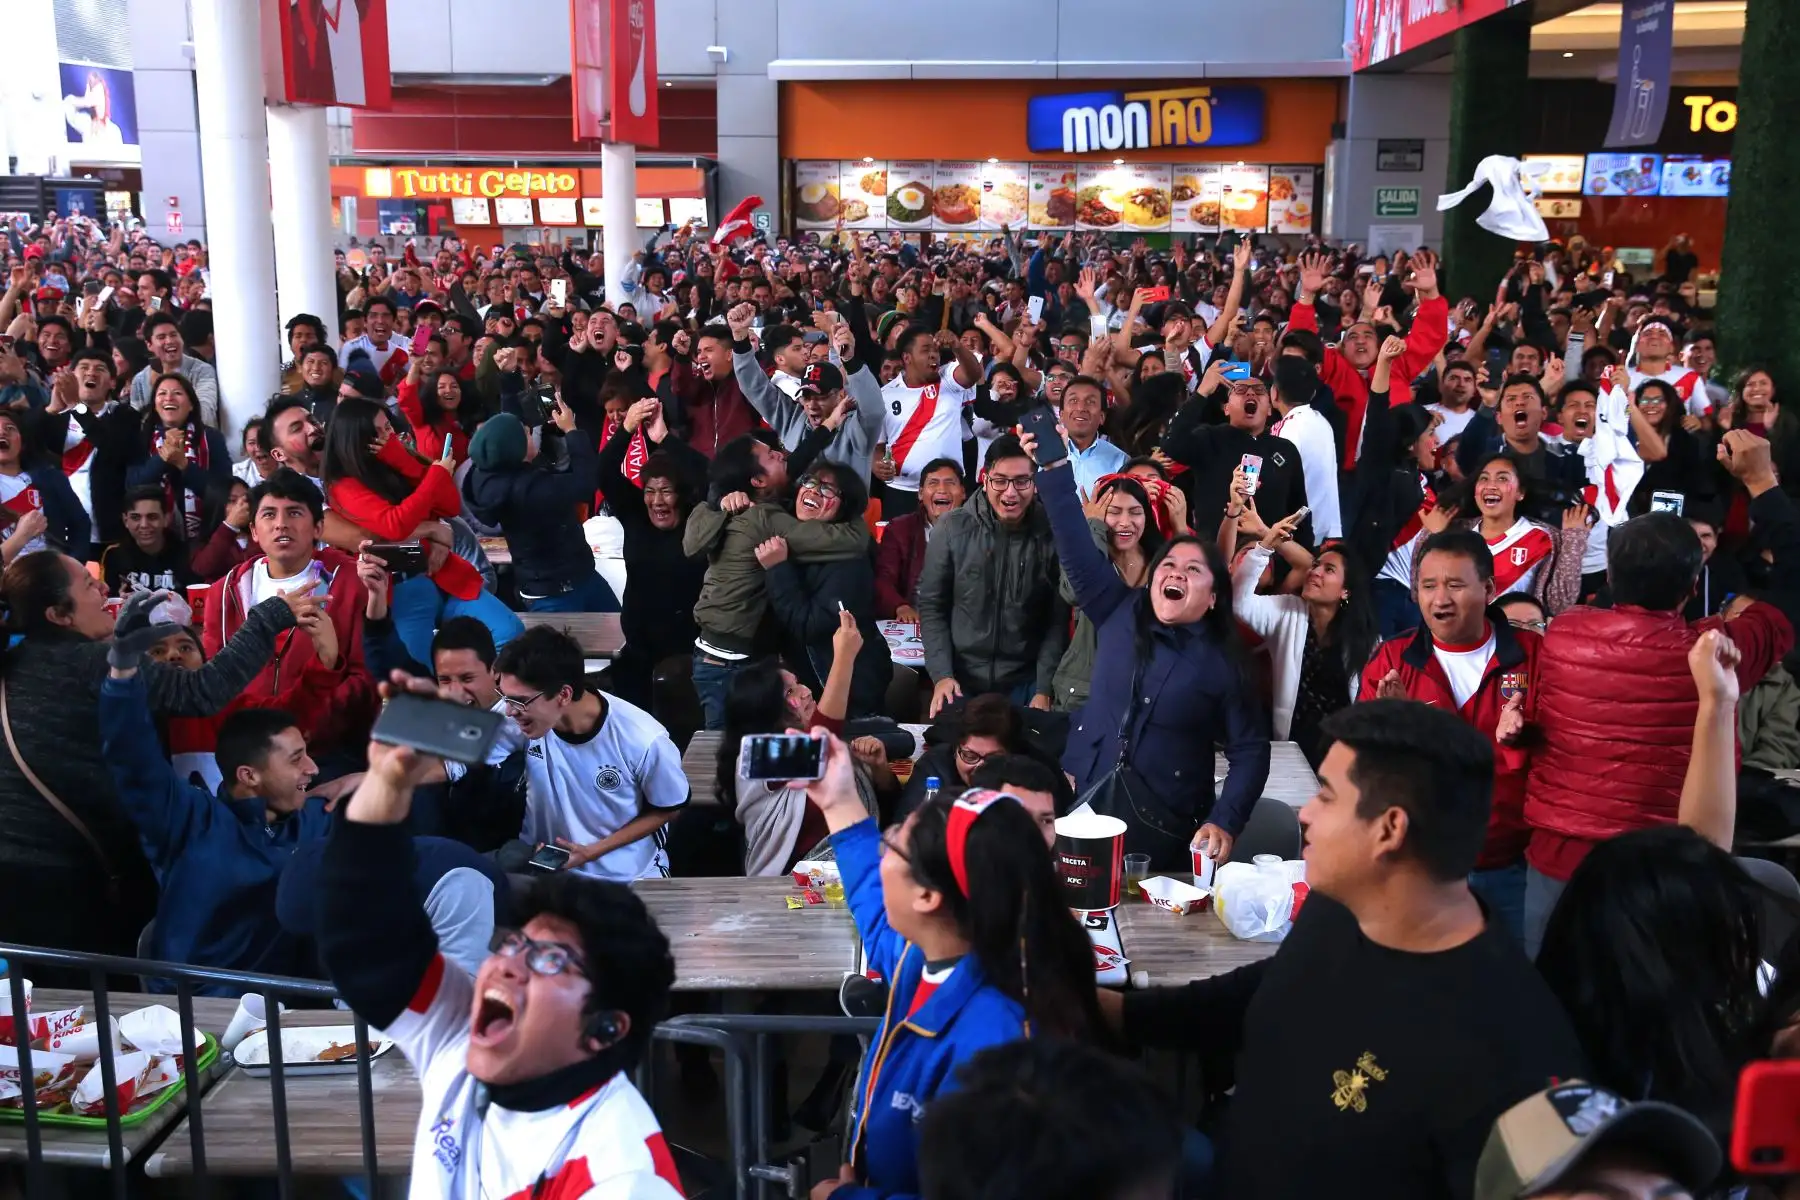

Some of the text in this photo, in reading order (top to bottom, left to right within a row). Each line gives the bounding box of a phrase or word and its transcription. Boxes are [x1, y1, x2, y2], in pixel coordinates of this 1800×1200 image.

[396, 169, 576, 197] Tutti Gelato
[1379, 190, 1417, 203] SALIDA
[757, 215, 769, 228] S
[891, 400, 902, 416] 9
[1062, 856, 1087, 867] RECETA
[1067, 876, 1082, 885] KFC
[1153, 897, 1172, 908] KFC
[54, 1009, 77, 1032] KFC
[53, 1025, 84, 1039] KING
